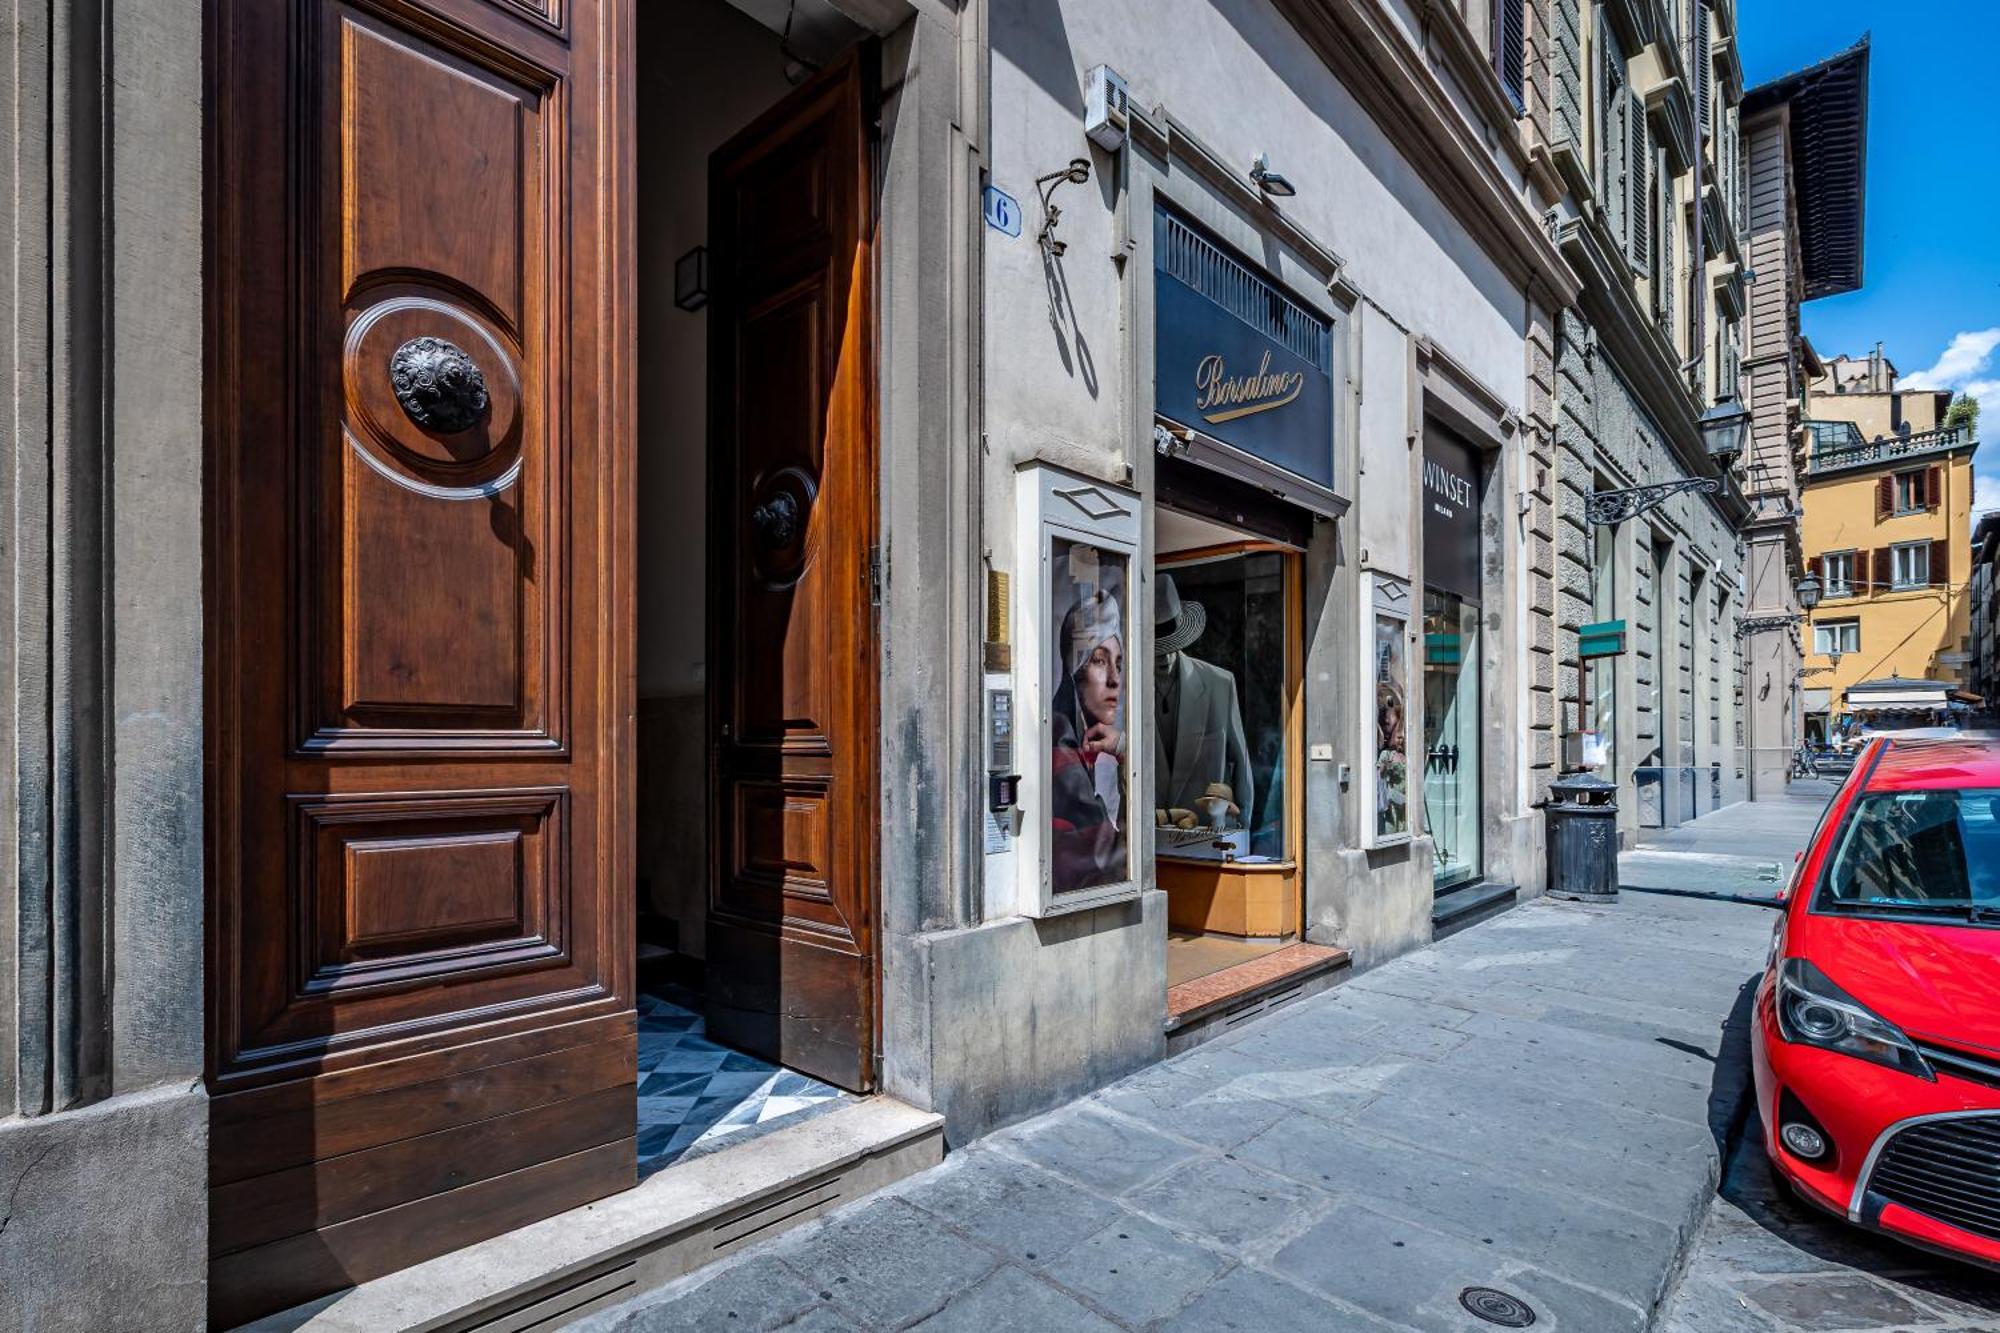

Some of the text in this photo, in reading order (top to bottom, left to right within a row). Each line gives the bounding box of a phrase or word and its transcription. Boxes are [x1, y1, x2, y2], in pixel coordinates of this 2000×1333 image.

[996, 197, 1009, 227] 6
[1196, 349, 1304, 424] Borsalino
[1423, 460, 1472, 509] WINSET
